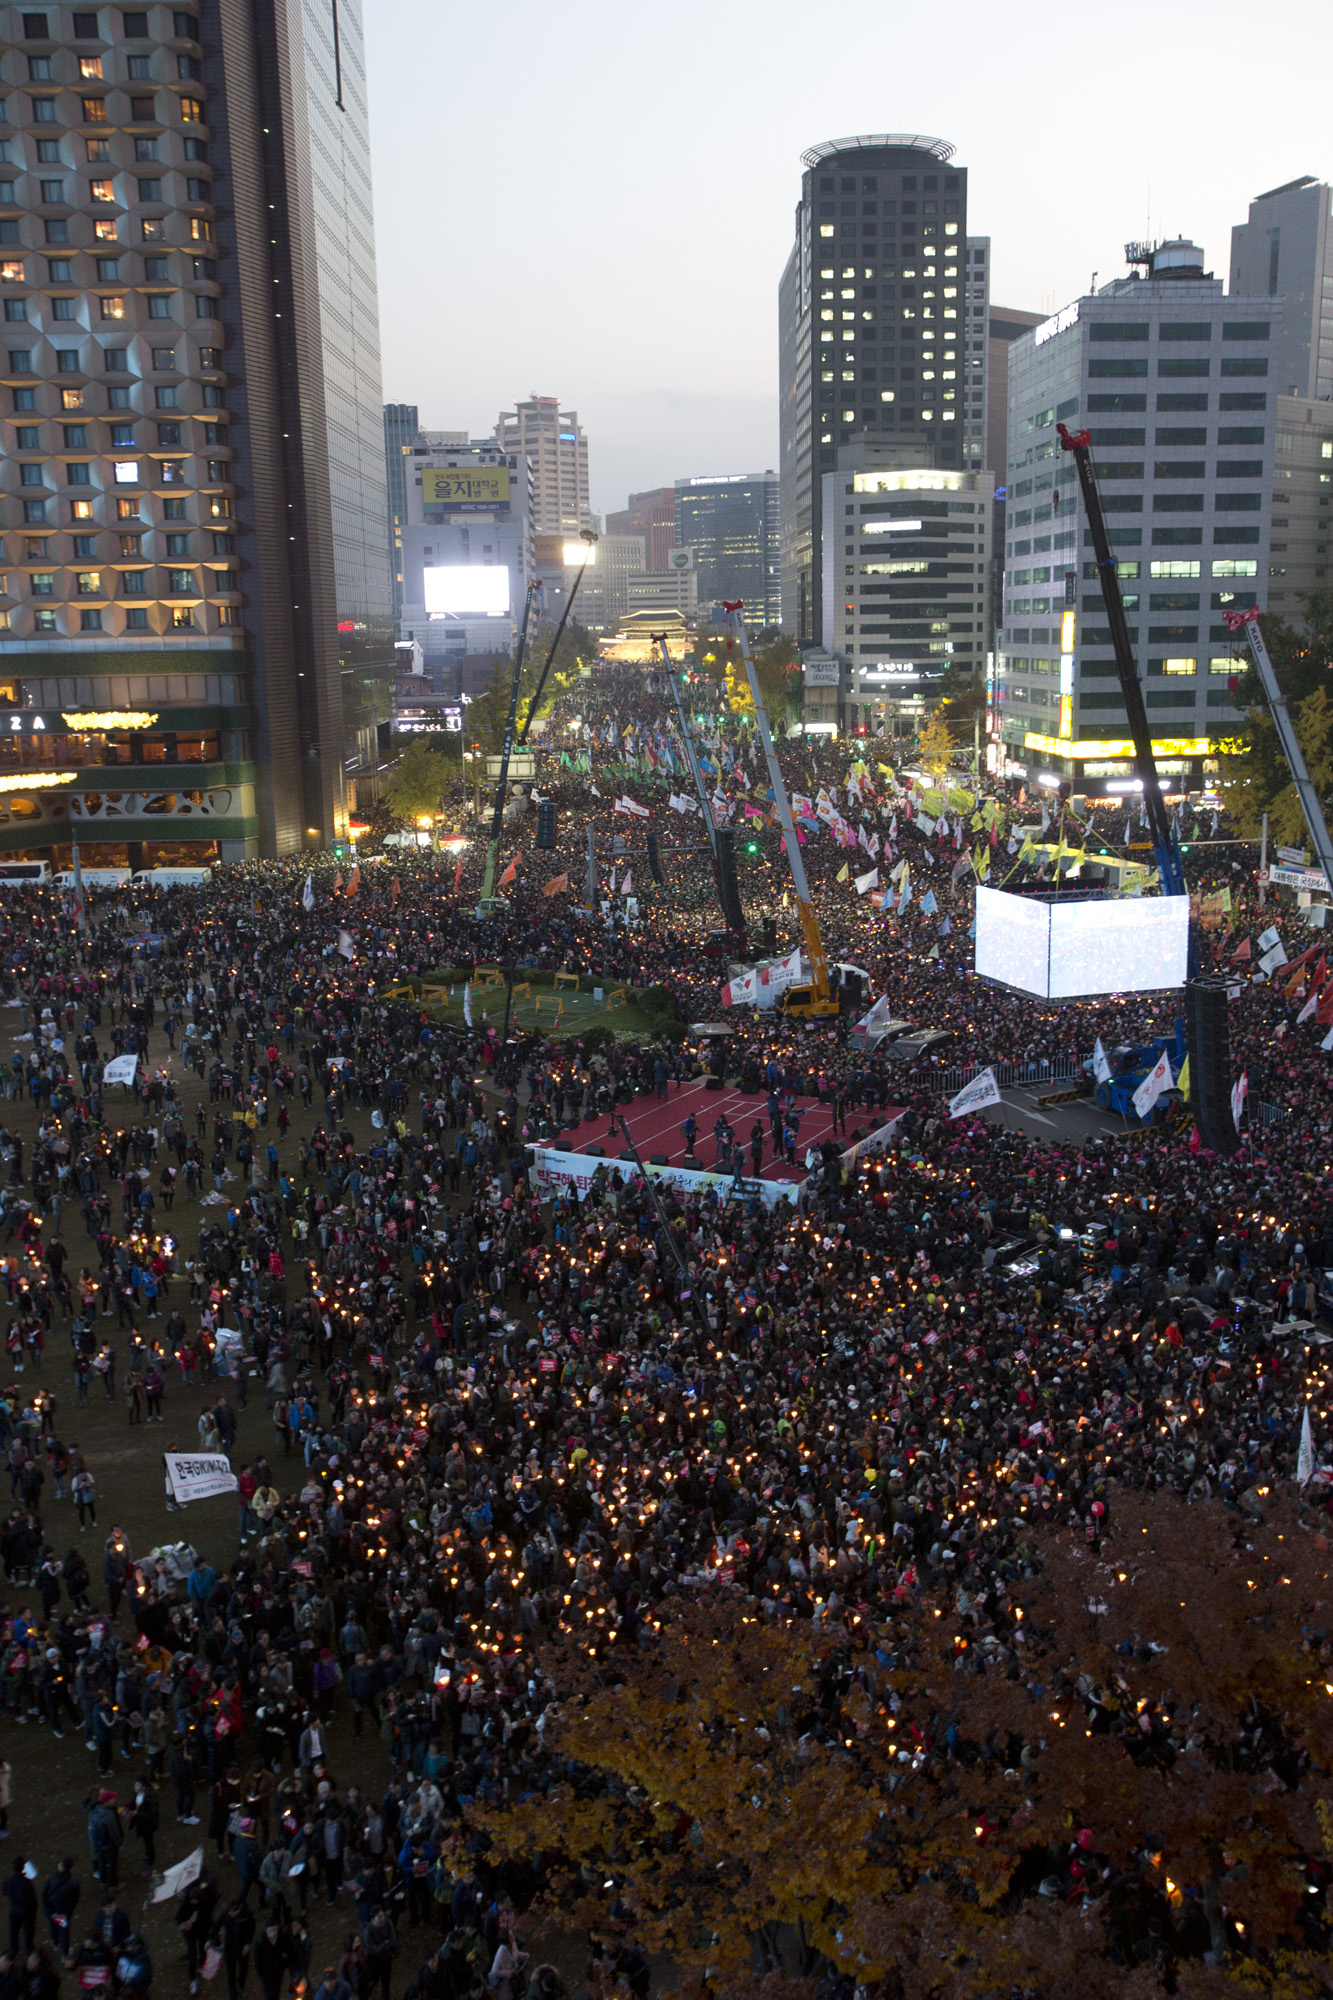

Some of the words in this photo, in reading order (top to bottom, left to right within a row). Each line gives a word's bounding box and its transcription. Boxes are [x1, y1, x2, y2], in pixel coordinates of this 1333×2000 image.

[433, 480, 472, 499] 을지
[472, 480, 499, 489] 대학교
[1250, 627, 1263, 653] KATO
[1274, 871, 1299, 885] 대통령은
[1301, 875, 1327, 890] 국정에서
[537, 1169, 574, 1187] 박근혜
